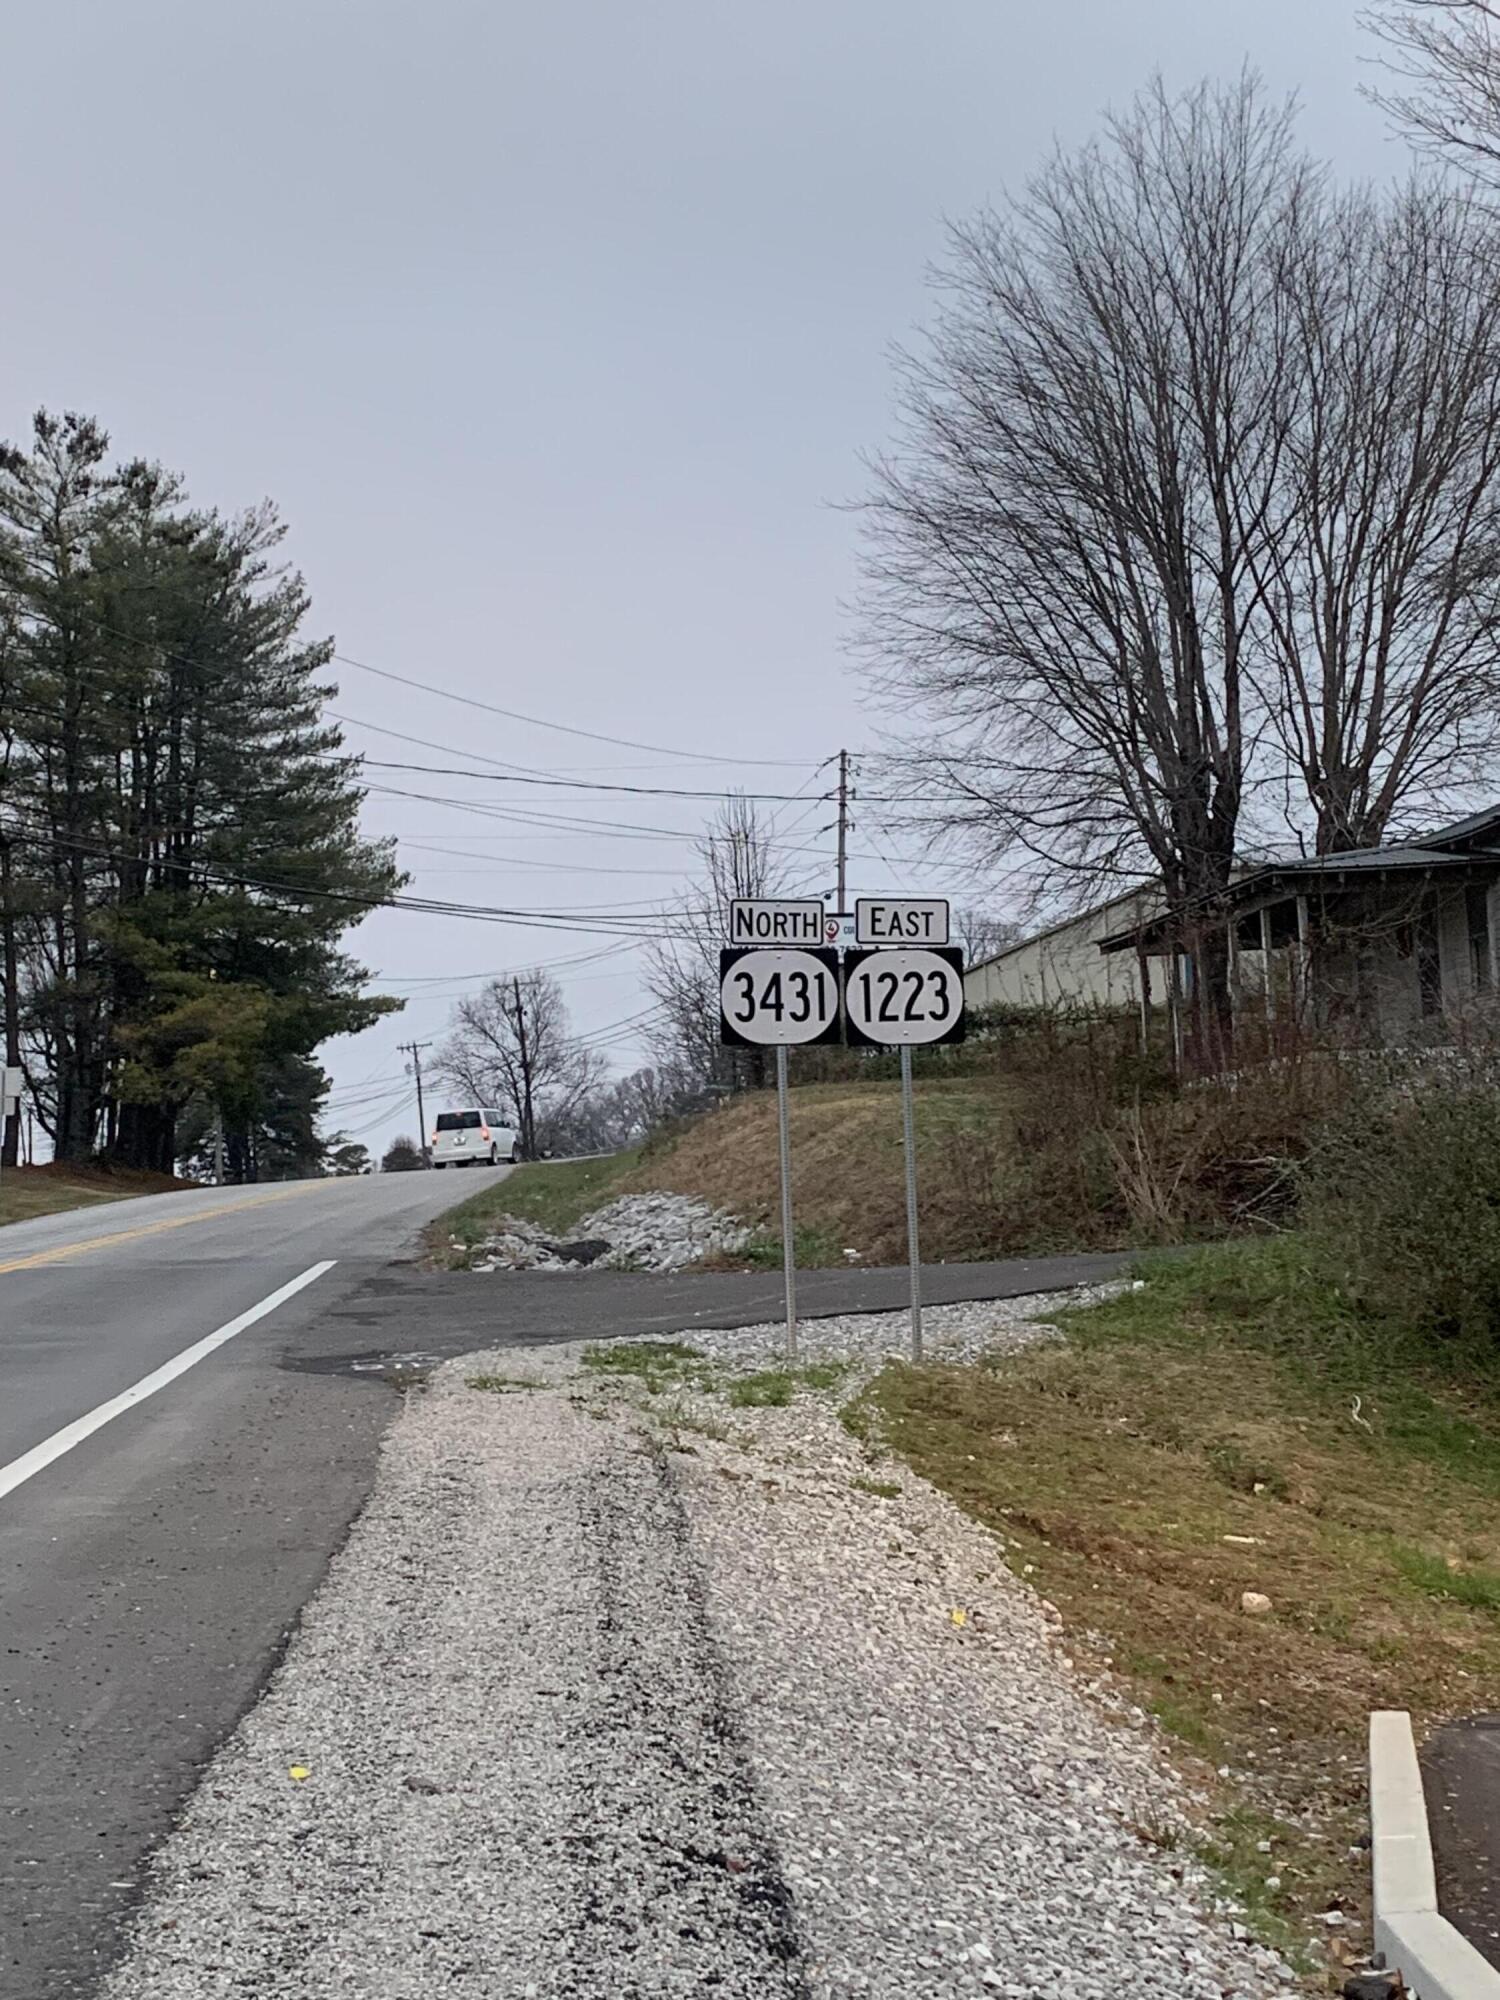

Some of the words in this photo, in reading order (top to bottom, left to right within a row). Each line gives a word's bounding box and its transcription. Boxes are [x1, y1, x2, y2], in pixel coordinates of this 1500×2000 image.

[737, 907, 818, 938] NORTH
[871, 907, 934, 936] EAST
[733, 971, 826, 1022] 3431
[859, 970, 950, 1023] 1223
